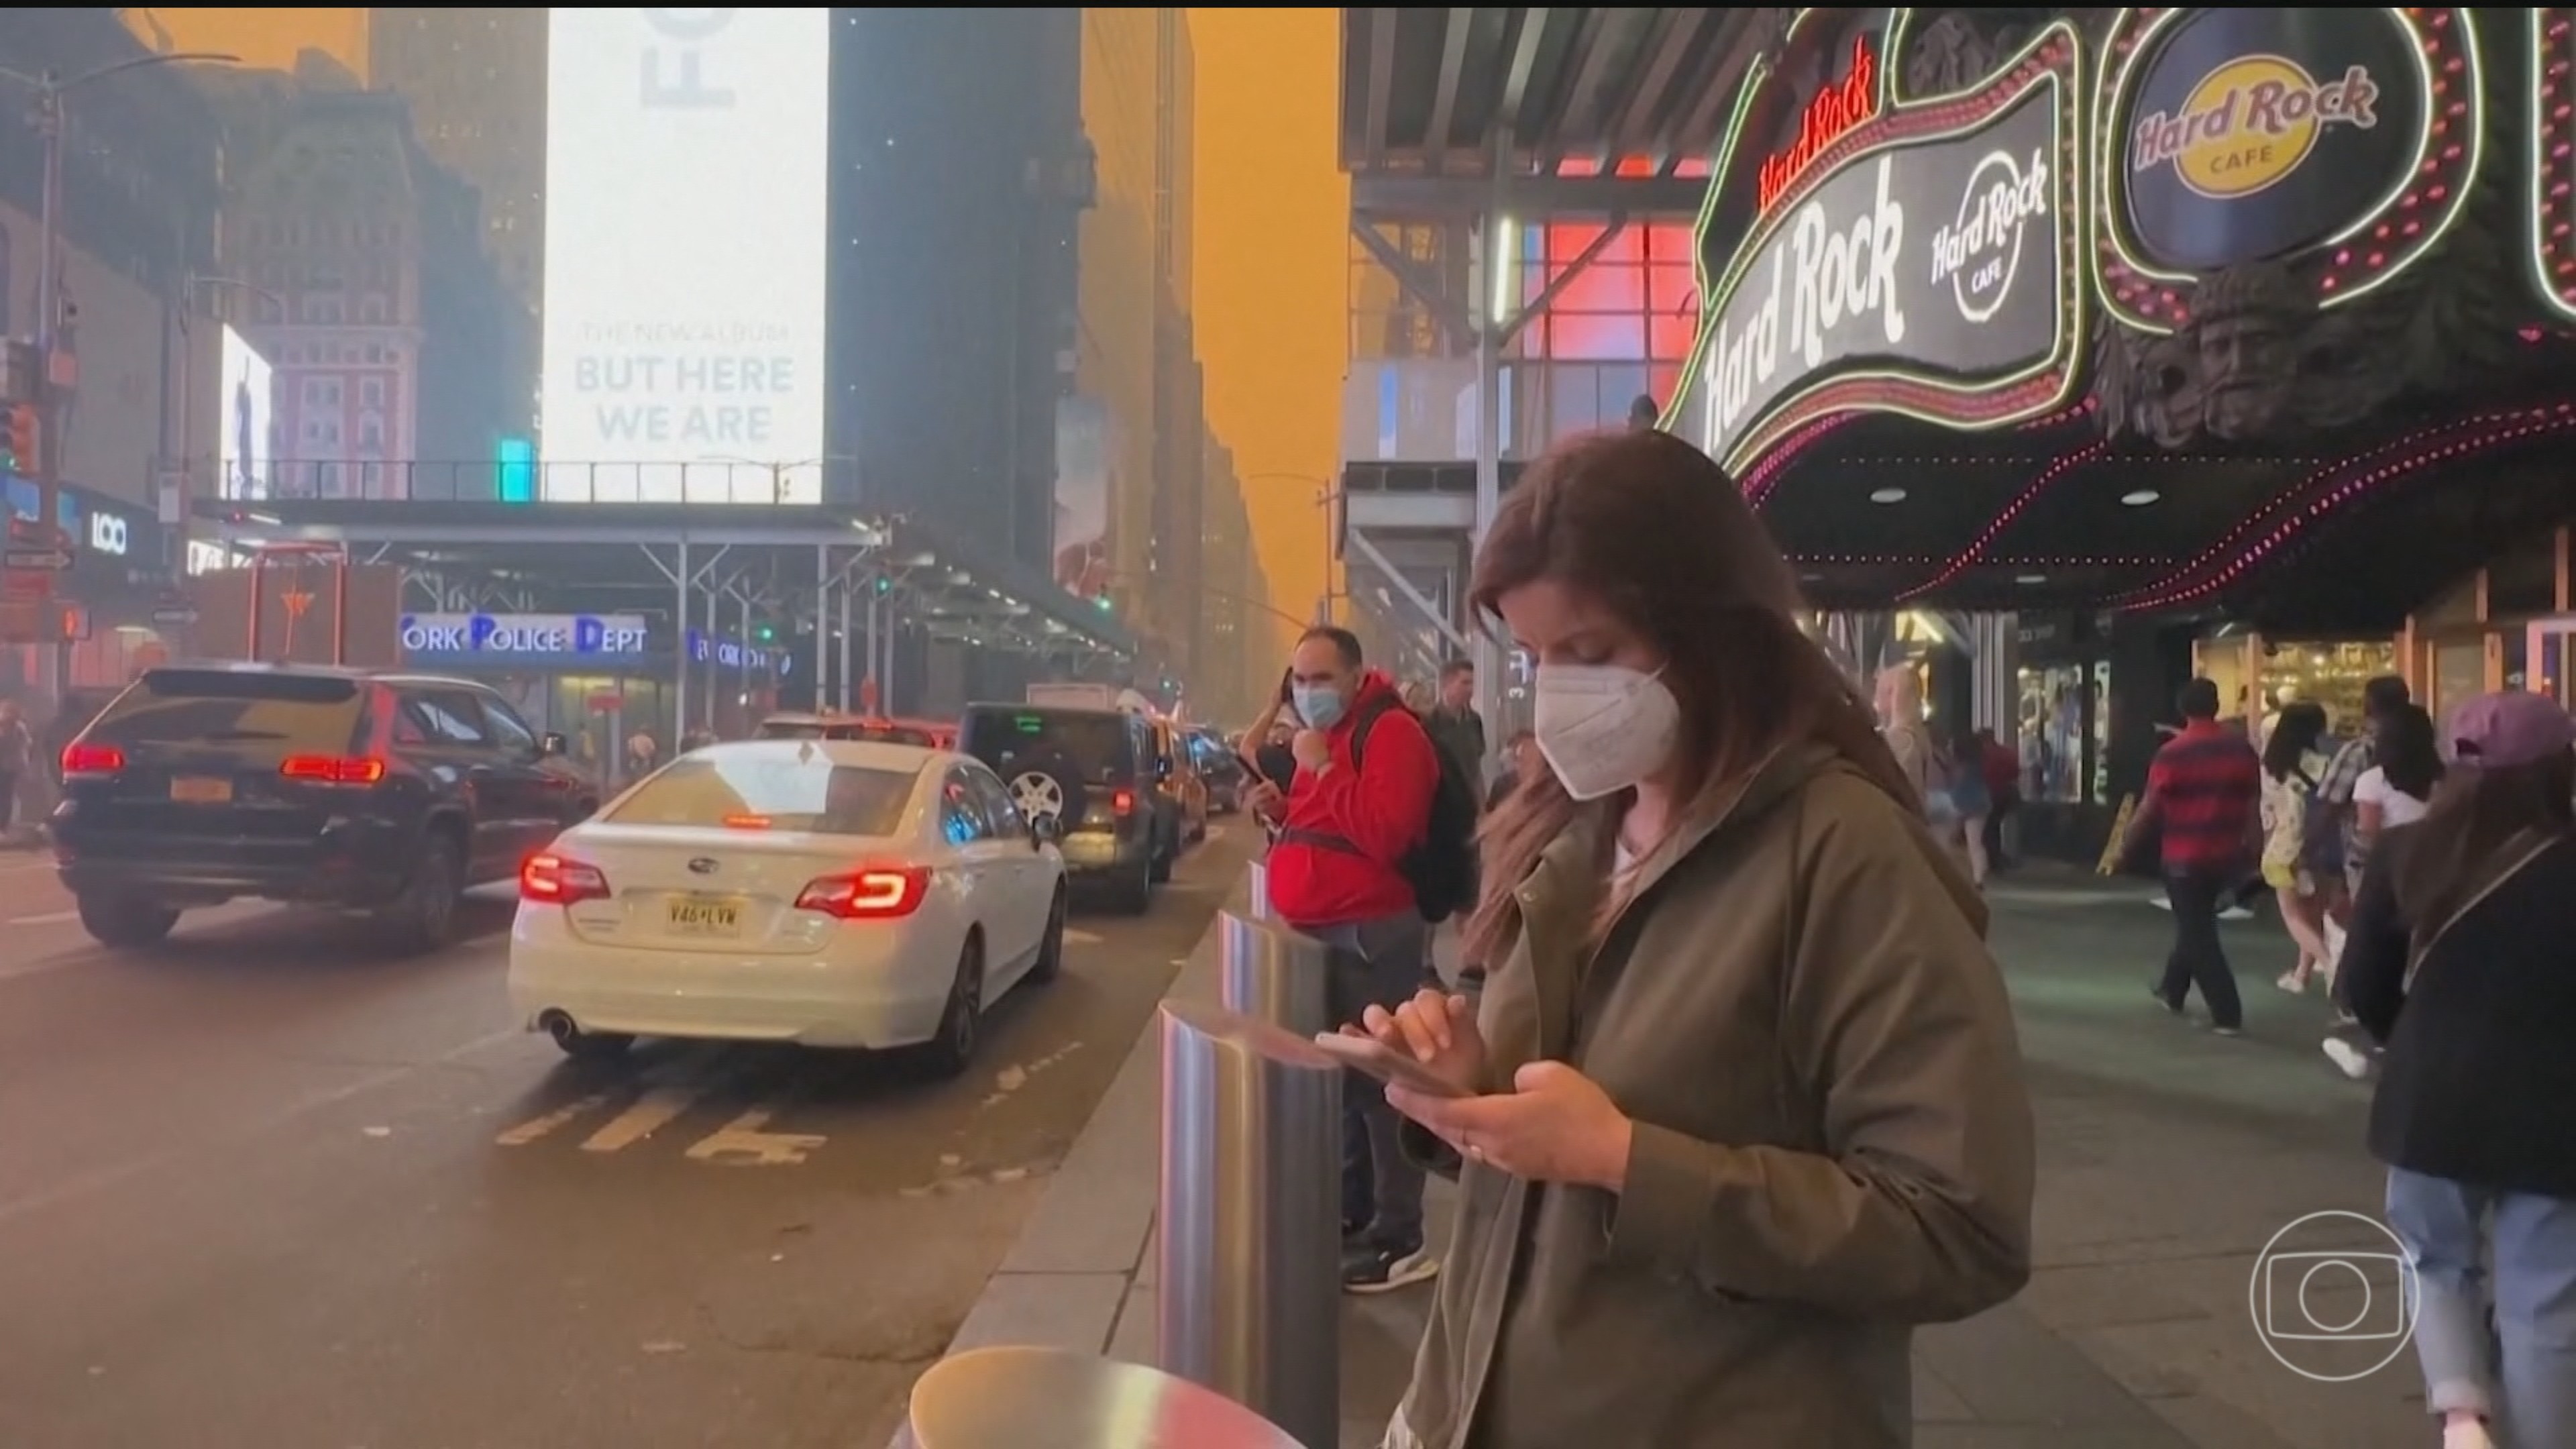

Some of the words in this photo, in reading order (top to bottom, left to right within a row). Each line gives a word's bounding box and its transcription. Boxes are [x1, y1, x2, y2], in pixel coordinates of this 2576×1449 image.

[1760, 108, 1810, 215] Hard
[1812, 36, 1872, 152] Rock
[2134, 89, 2239, 170] Hard
[2246, 66, 2379, 133] Rock
[2209, 145, 2273, 174] CAFE
[1931, 195, 1986, 284] Hard
[1987, 147, 2047, 247] Rock
[1972, 256, 2002, 294] CAFE
[1704, 245, 1783, 454] Hard
[1792, 154, 1904, 368] Rock
[575, 356, 664, 392] BUT
[676, 356, 794, 393] HERE
[596, 405, 669, 441] WE
[680, 405, 772, 442] ARE
[400, 615, 461, 651] ORK
[470, 614, 564, 652] POLICE
[575, 614, 646, 652] DEPT
